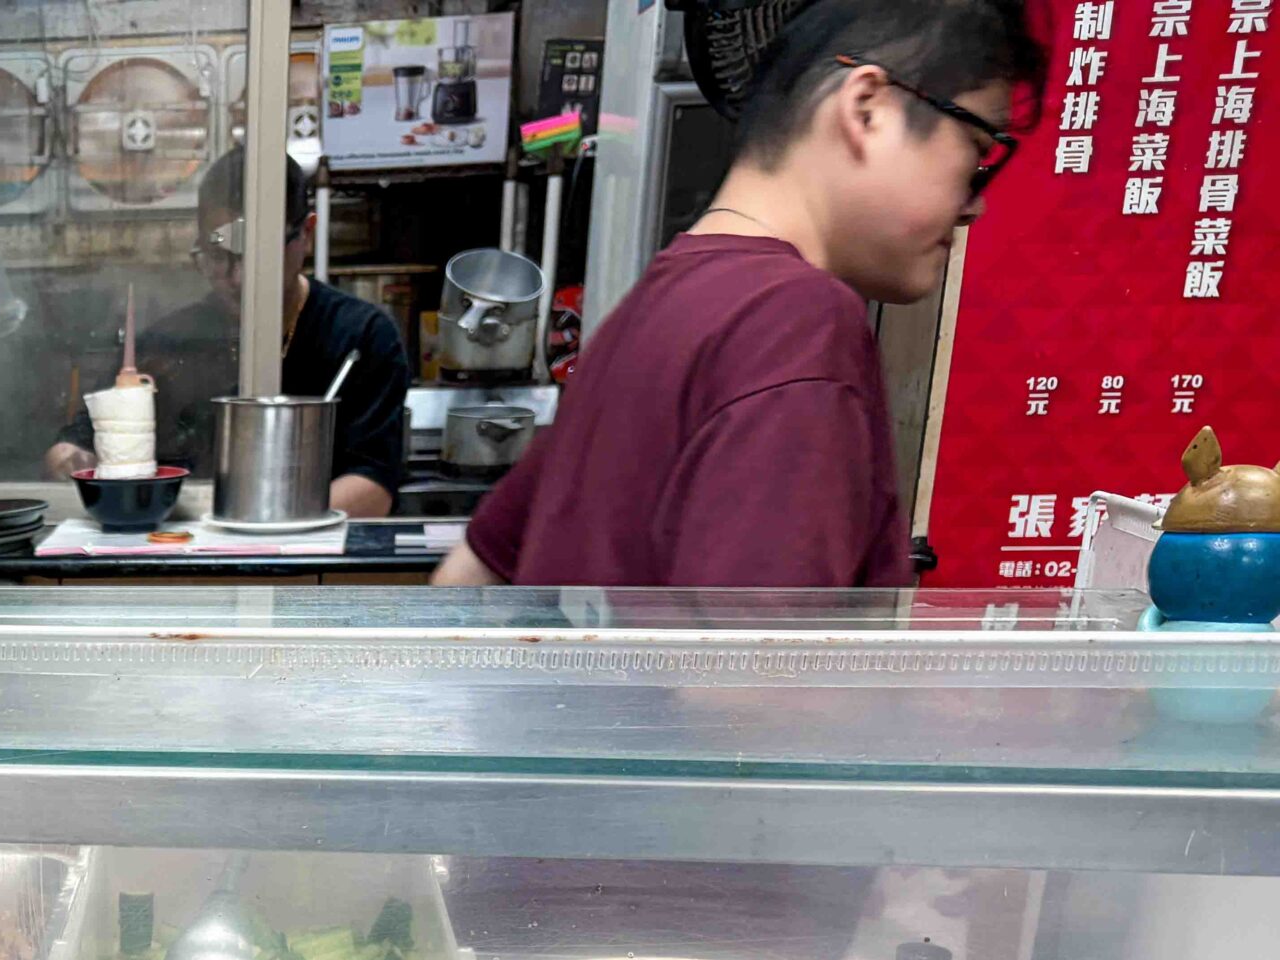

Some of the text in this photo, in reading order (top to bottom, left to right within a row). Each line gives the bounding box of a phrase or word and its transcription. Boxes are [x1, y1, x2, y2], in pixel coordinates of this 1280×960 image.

[1054, 0, 1114, 174] 制炸排骨
[1026, 377, 1058, 390] 120
[1101, 376, 1124, 389] 80
[1171, 375, 1203, 388] 170
